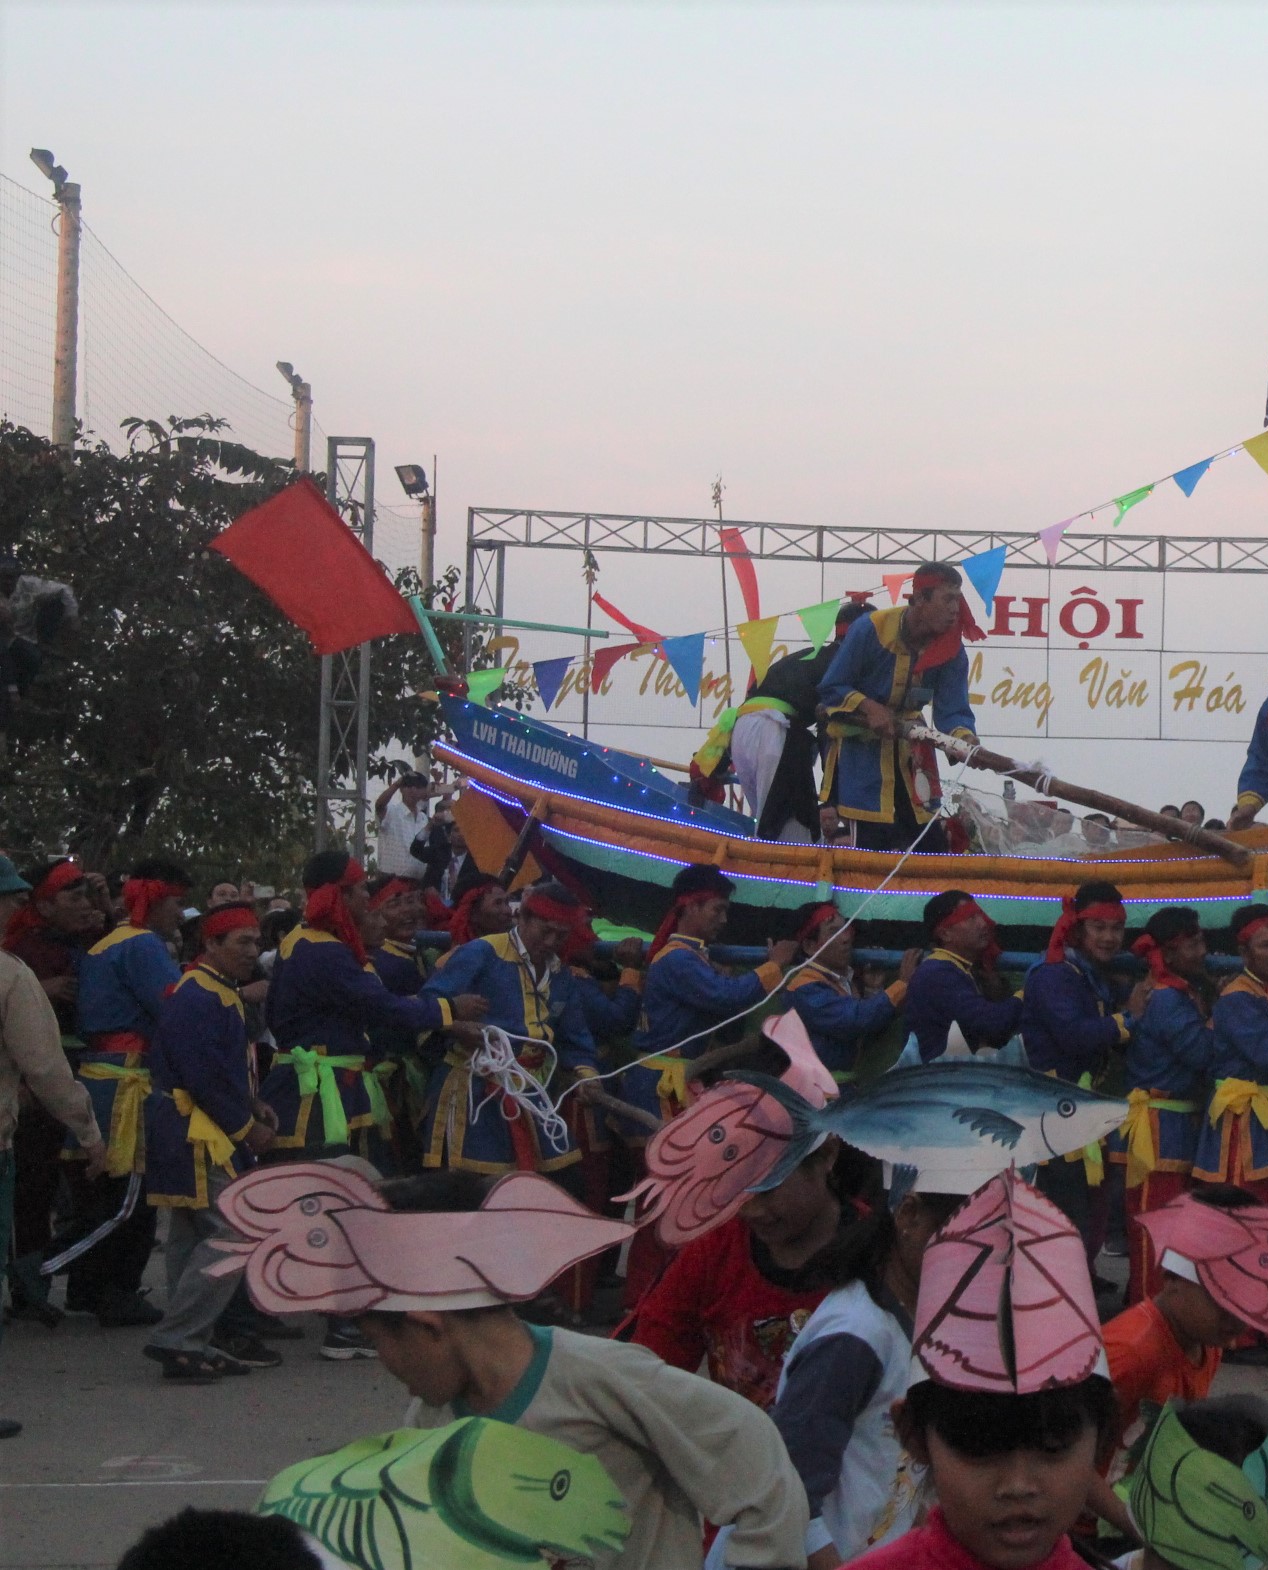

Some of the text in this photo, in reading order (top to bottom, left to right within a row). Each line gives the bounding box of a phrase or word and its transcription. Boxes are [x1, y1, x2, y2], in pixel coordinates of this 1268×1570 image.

[988, 586, 1143, 650] HỘI
[968, 651, 1054, 728] Làng
[1079, 656, 1149, 710] Văn
[1168, 660, 1246, 714] Hóa
[473, 719, 498, 746] LVH
